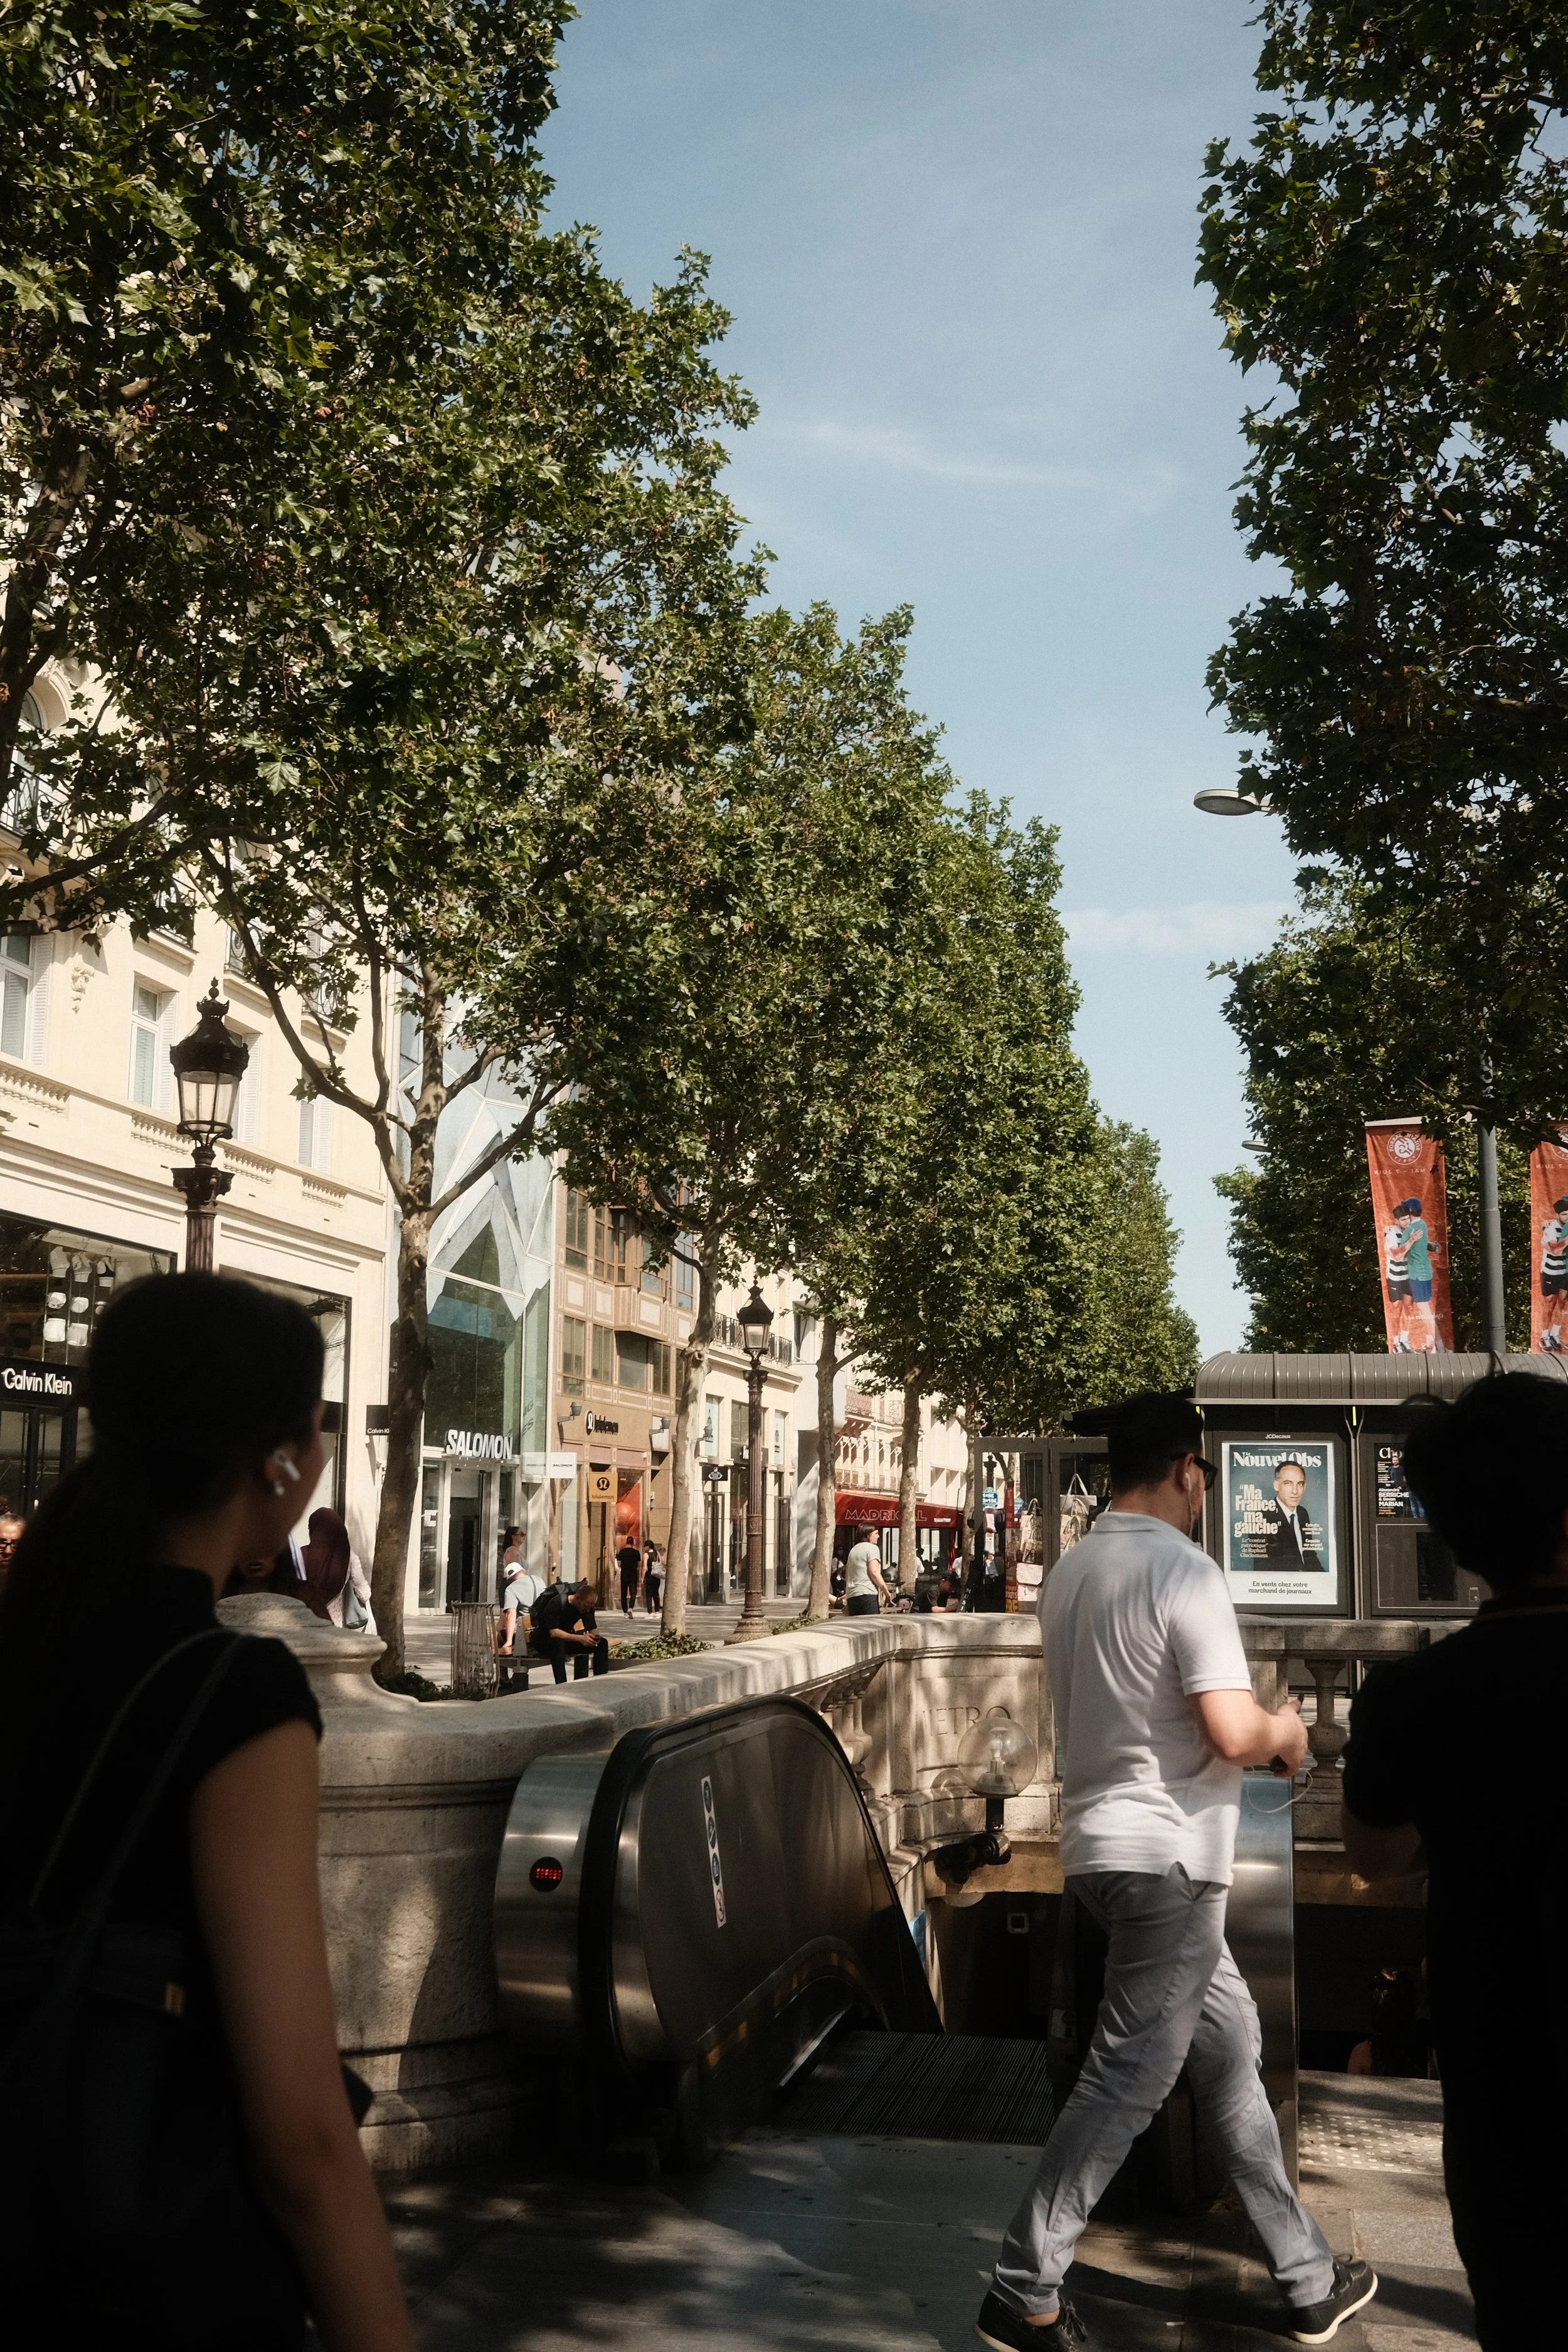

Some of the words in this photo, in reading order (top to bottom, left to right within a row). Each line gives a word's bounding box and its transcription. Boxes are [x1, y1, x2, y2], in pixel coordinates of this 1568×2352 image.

[2, 1368, 43, 1392] Calvin
[45, 1372, 72, 1395] Klein
[446, 1429, 513, 1459] SALOMON
[1232, 1451, 1287, 1467] Nouvel
[1288, 1451, 1322, 1468] Obs
[1235, 1495, 1278, 1513] France,
[845, 1509, 927, 1522] MADRIL
[1244, 1512, 1263, 1523] ma
